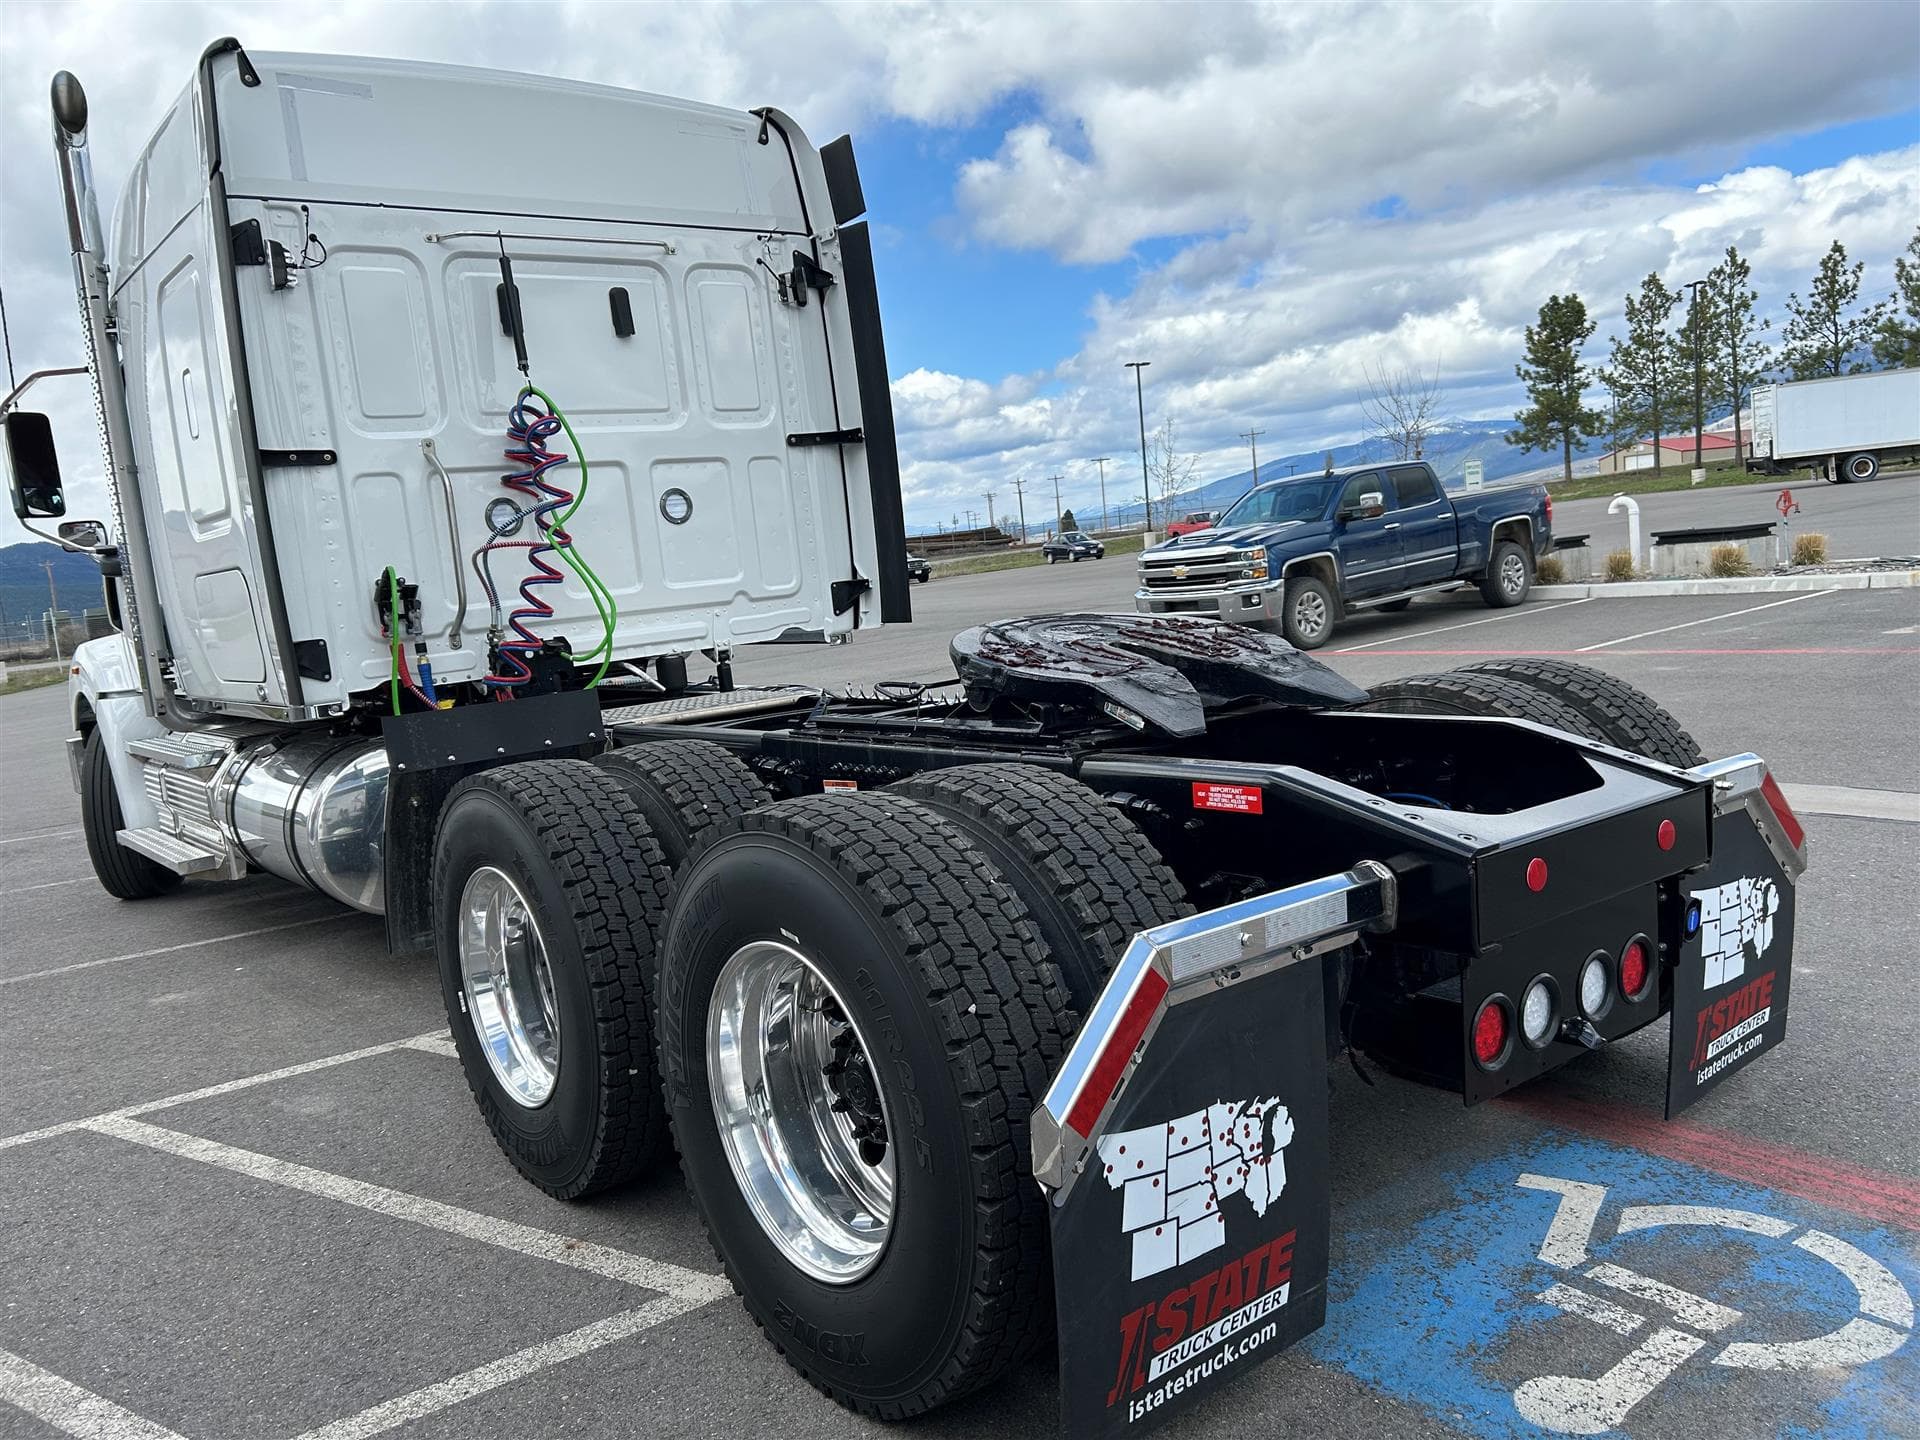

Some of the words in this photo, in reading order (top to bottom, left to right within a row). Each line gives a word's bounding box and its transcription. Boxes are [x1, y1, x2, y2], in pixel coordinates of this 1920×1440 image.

[1209, 786, 1243, 794] IMPORTANT
[1710, 1032, 1737, 1055] TRUCK
[1737, 1010, 1766, 1037] CENTER
[1696, 1033, 1763, 1086] istatetruck.com
[1157, 1326, 1215, 1375] TRUCK
[1219, 1289, 1282, 1337] CENTER
[1128, 1321, 1278, 1424] istatetruck.com
